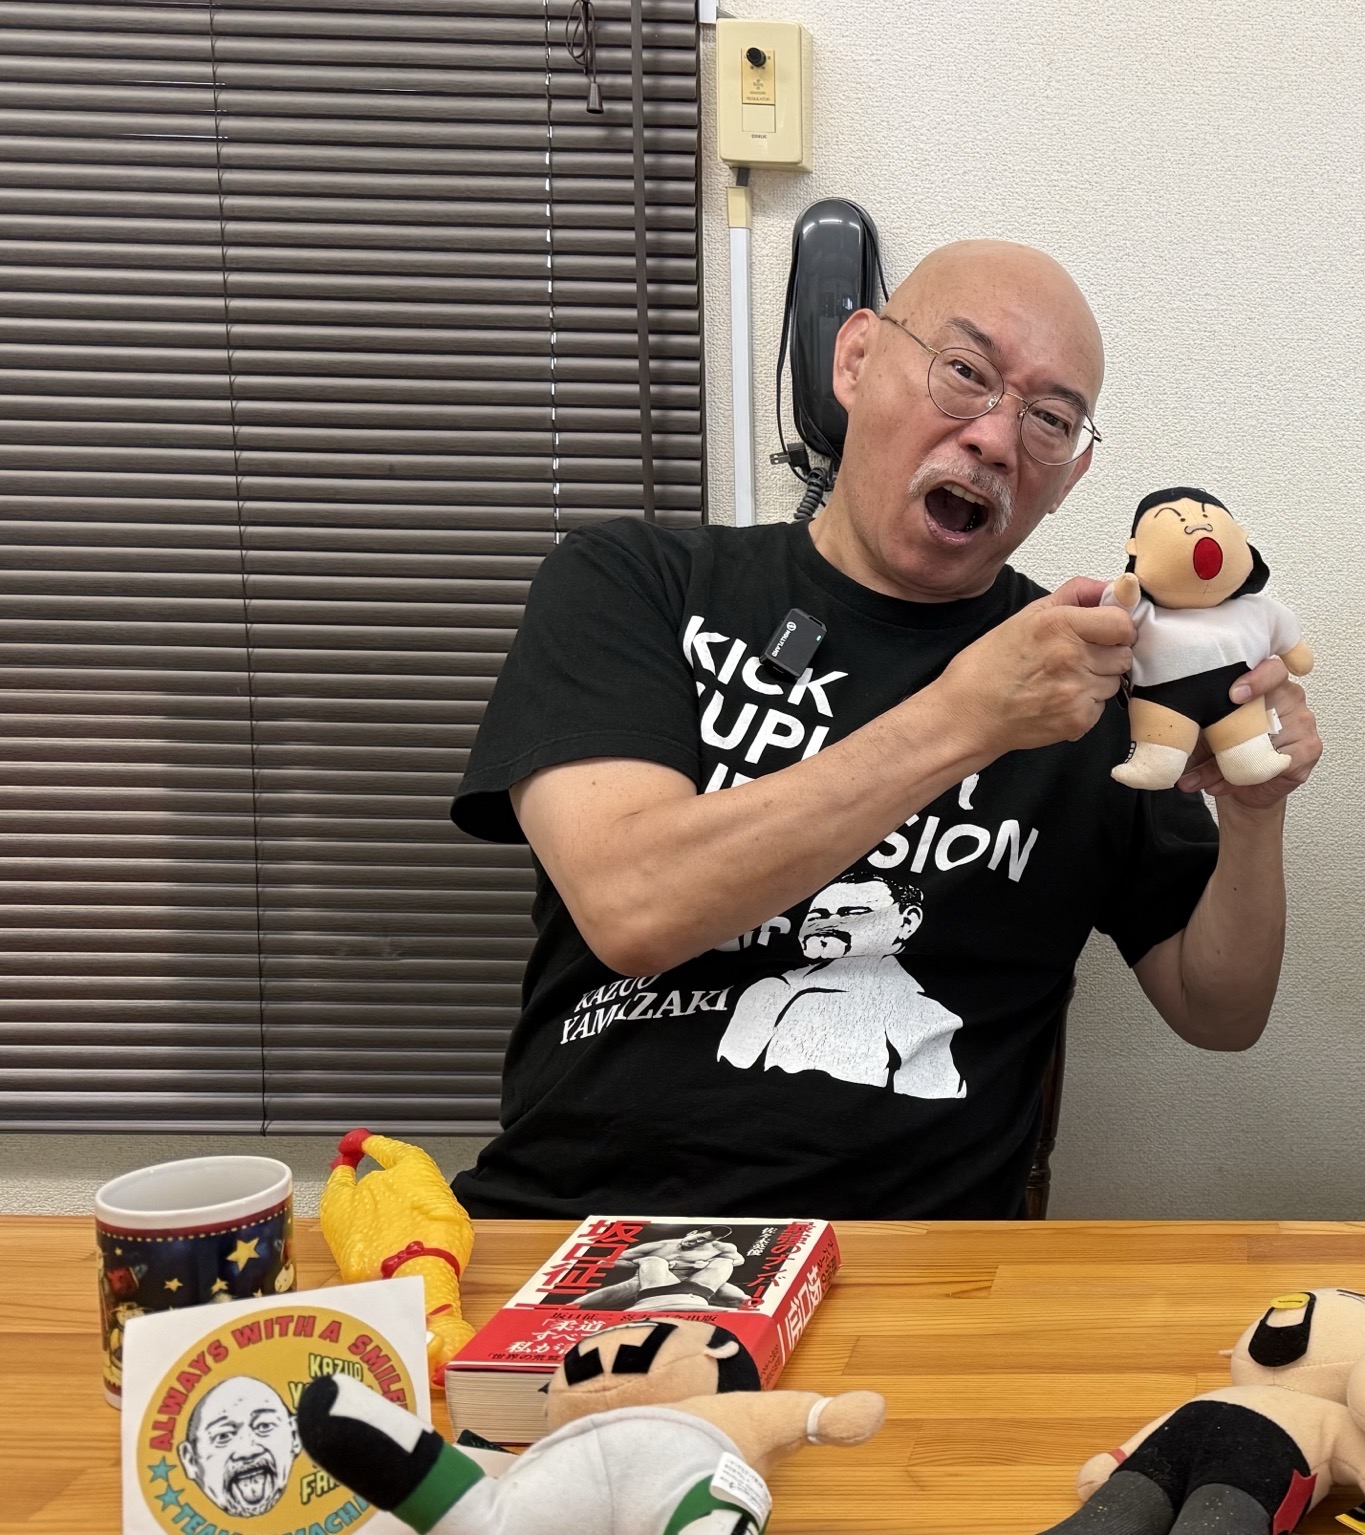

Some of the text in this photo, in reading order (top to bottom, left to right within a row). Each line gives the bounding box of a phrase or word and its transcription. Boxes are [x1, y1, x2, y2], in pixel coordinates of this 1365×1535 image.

[515, 1219, 651, 1309] 坂口征二
[149, 1339, 229, 1452] ALWAYS
[231, 1314, 316, 1349] WITH
[319, 1320, 342, 1343] A
[347, 1334, 408, 1411] SMILE
